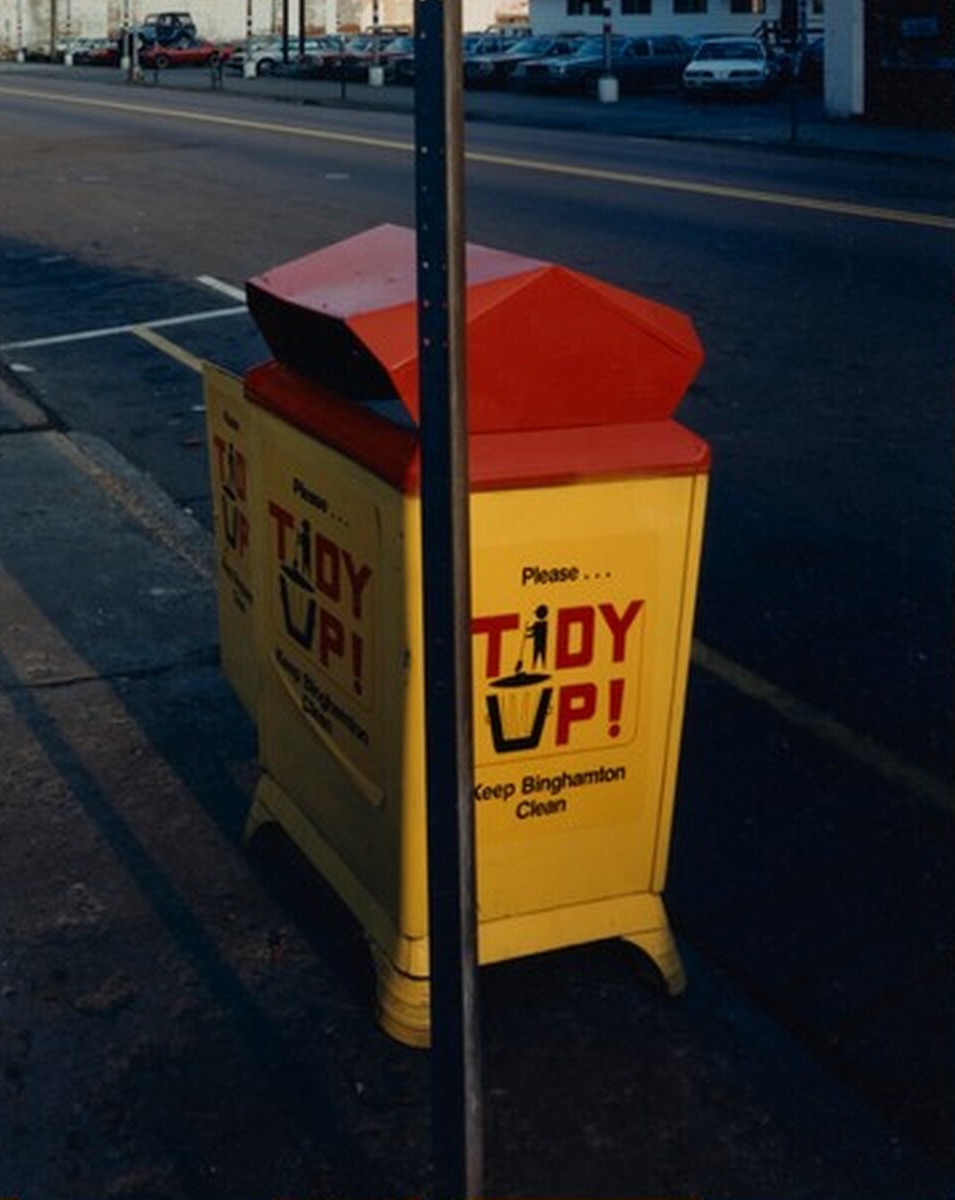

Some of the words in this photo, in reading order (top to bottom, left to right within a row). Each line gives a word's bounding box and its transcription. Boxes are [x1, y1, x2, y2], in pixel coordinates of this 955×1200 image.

[485, 678, 625, 754] UP!
[521, 765, 626, 796] Binghamton
[515, 798, 567, 820] Clean
